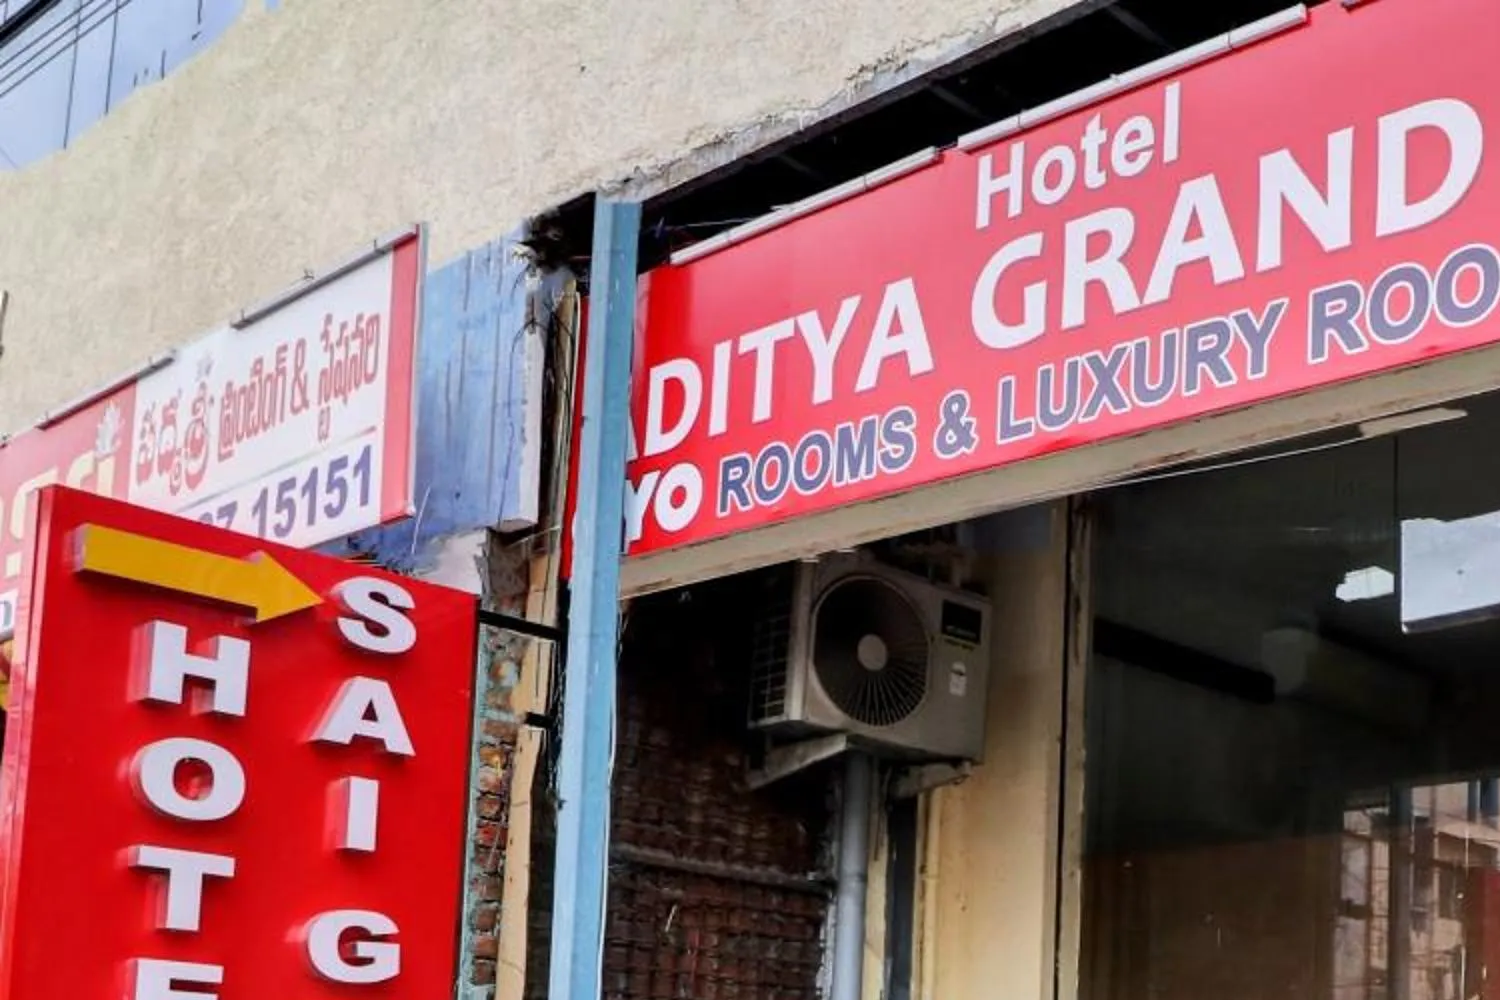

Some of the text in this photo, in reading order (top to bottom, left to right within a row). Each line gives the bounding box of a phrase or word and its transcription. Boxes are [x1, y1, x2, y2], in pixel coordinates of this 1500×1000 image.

[975, 81, 1181, 230] Hotel
[290, 337, 309, 416] &
[627, 277, 935, 461] DITYA
[970, 97, 1483, 350] GRAND
[252, 444, 371, 540] 15151
[573, 461, 703, 542] YO
[716, 407, 917, 518] ROOMS
[934, 391, 978, 459] &
[994, 298, 1290, 446] LUXURY
[309, 576, 417, 853] SAI
